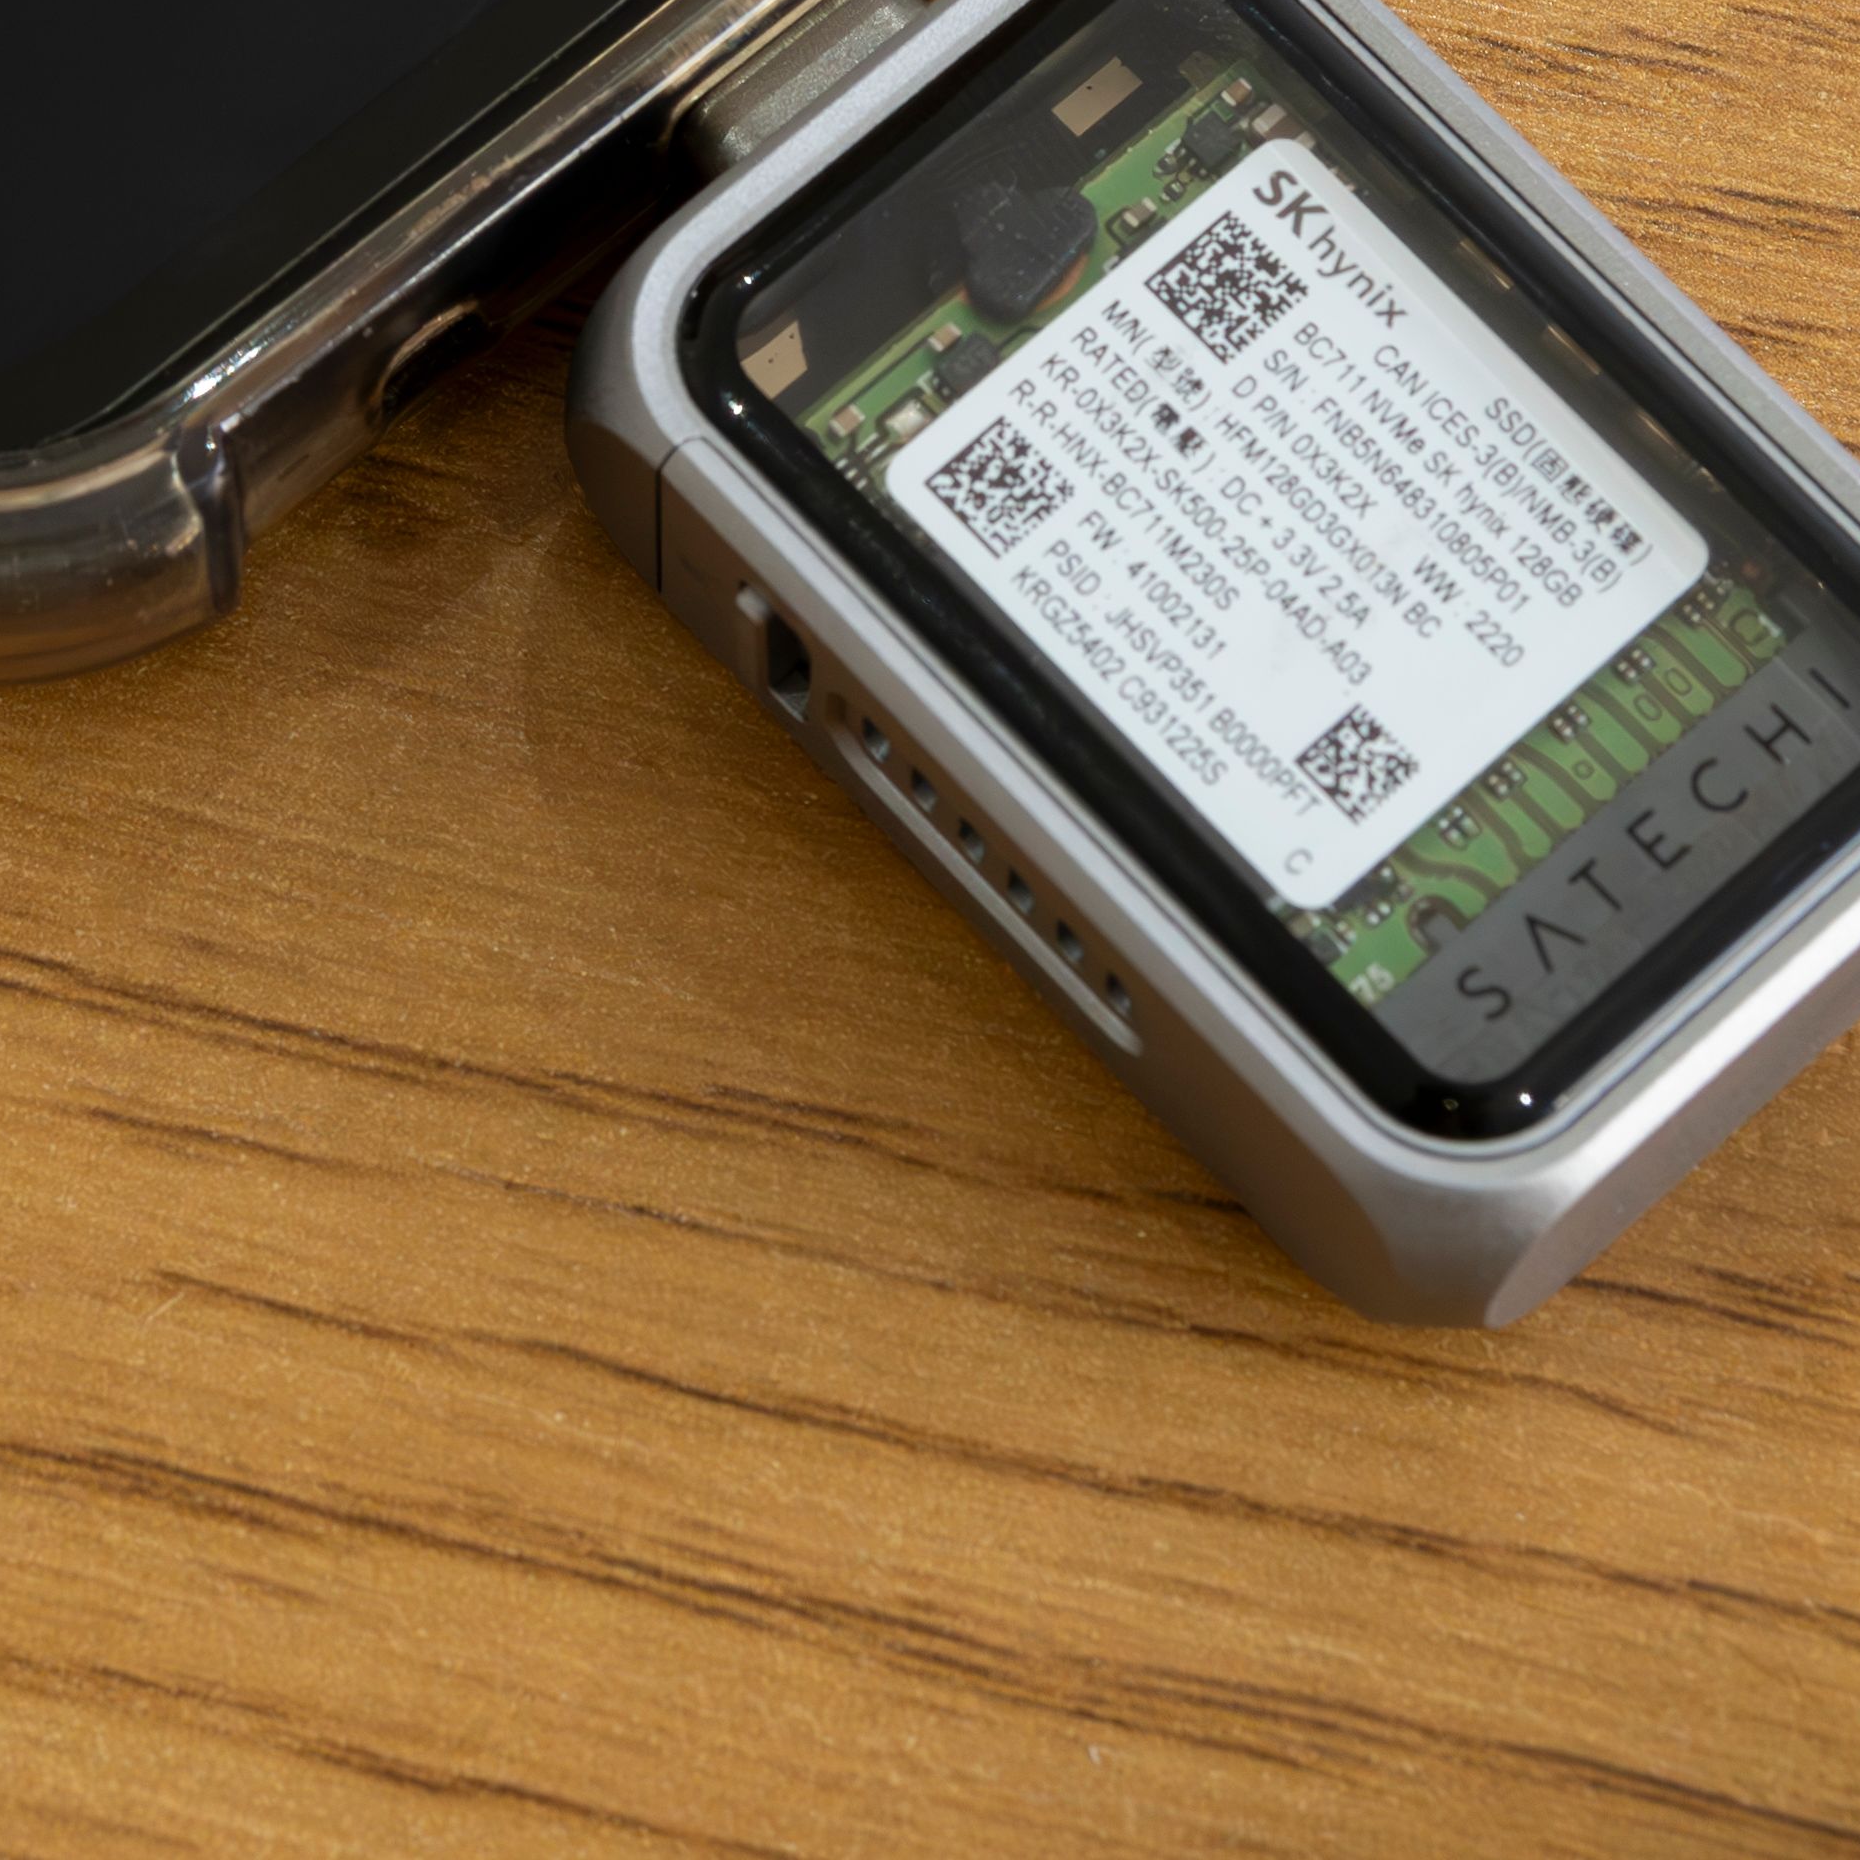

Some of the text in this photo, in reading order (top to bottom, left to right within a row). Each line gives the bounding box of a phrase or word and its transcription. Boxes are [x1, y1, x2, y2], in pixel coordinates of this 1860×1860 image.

[1252, 169, 1406, 327] SK hynix
[1263, 349, 1307, 392] S/N
[1253, 394, 1297, 438] P/N
[1293, 321, 1582, 606] BC711 NVMe SK hynix 128GB
[1374, 344, 1621, 591] CAN ICES-3(B)/NMB-3(B)
[1219, 475, 1262, 515] DC
[1046, 539, 1100, 594] PSID
[1079, 509, 1121, 550] FW
[1127, 561, 1225, 653] 41002131
[1403, 601, 1440, 636] BC
[1413, 557, 1457, 602] WW
[1464, 610, 1523, 665] 2220
[1284, 848, 1312, 874] C
